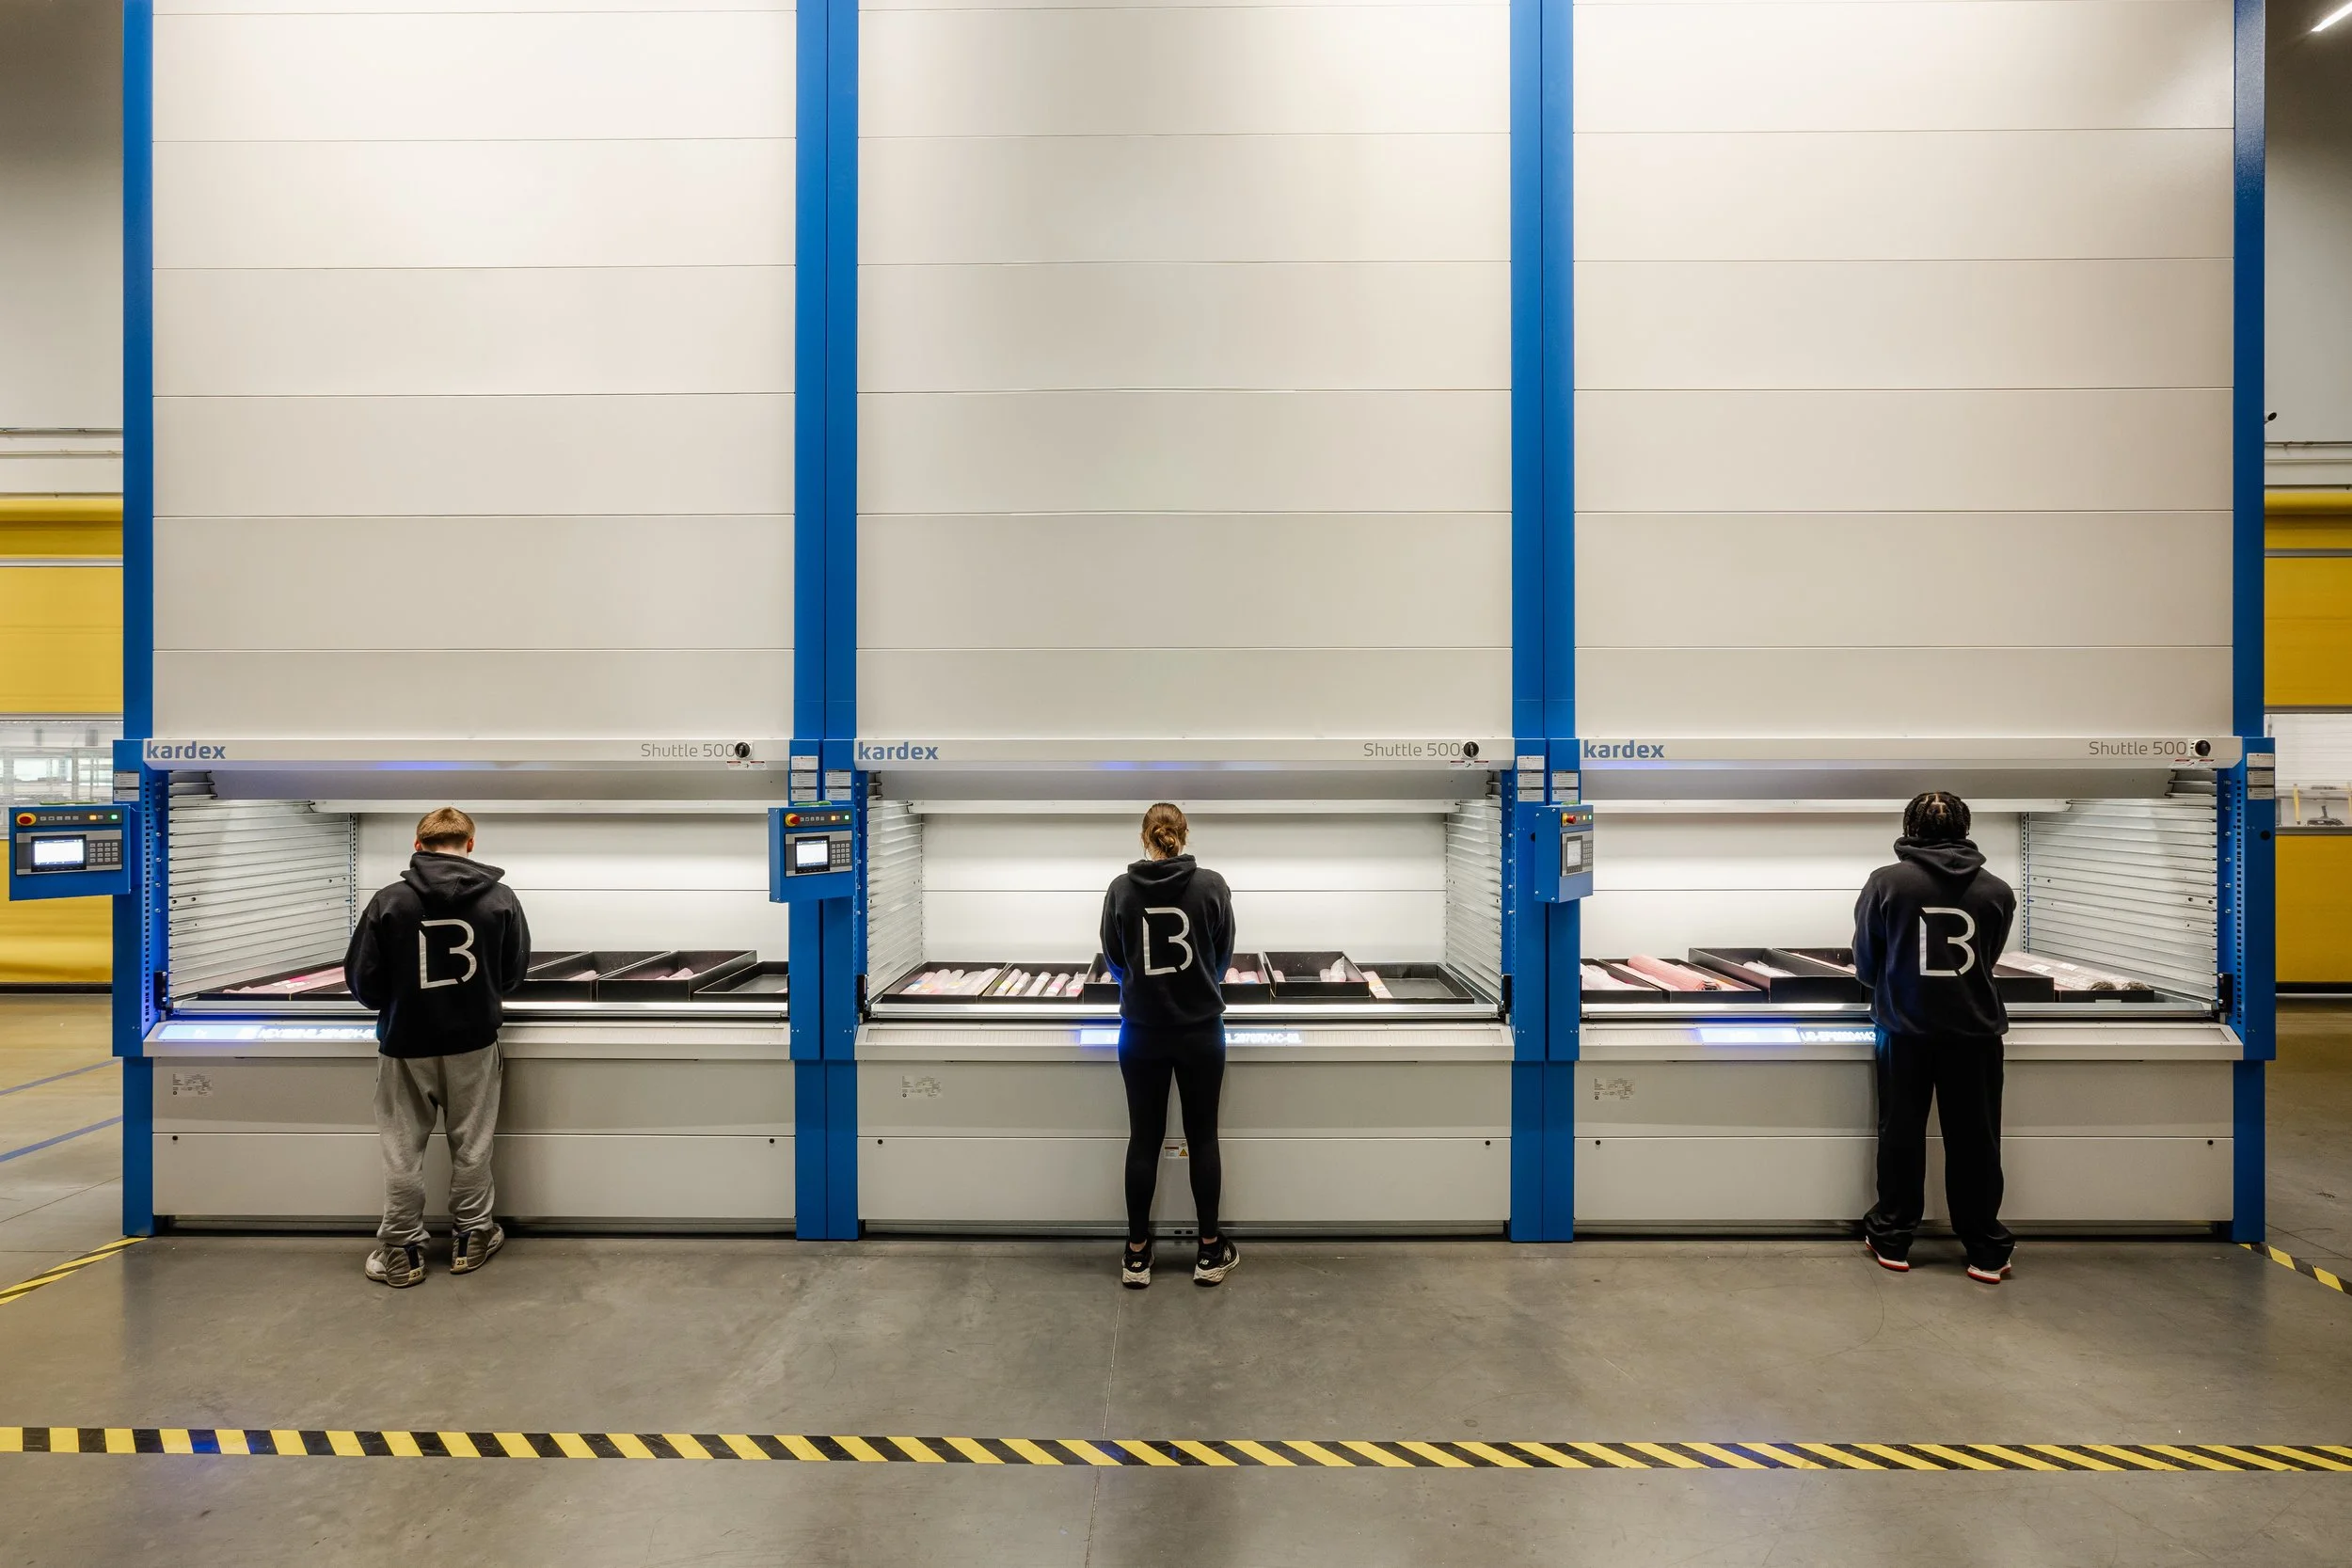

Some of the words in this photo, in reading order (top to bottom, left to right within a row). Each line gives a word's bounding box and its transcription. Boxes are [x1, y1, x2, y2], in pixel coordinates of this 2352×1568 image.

[147, 741, 226, 759] kardex
[641, 743, 698, 757] Shuttle
[859, 742, 938, 760] kardex
[1363, 743, 1422, 757] Shuttle
[1426, 743, 1460, 757] 500
[1584, 740, 1664, 758] kardex
[2089, 741, 2148, 755] Shuttle
[2153, 741, 2186, 755] 500
